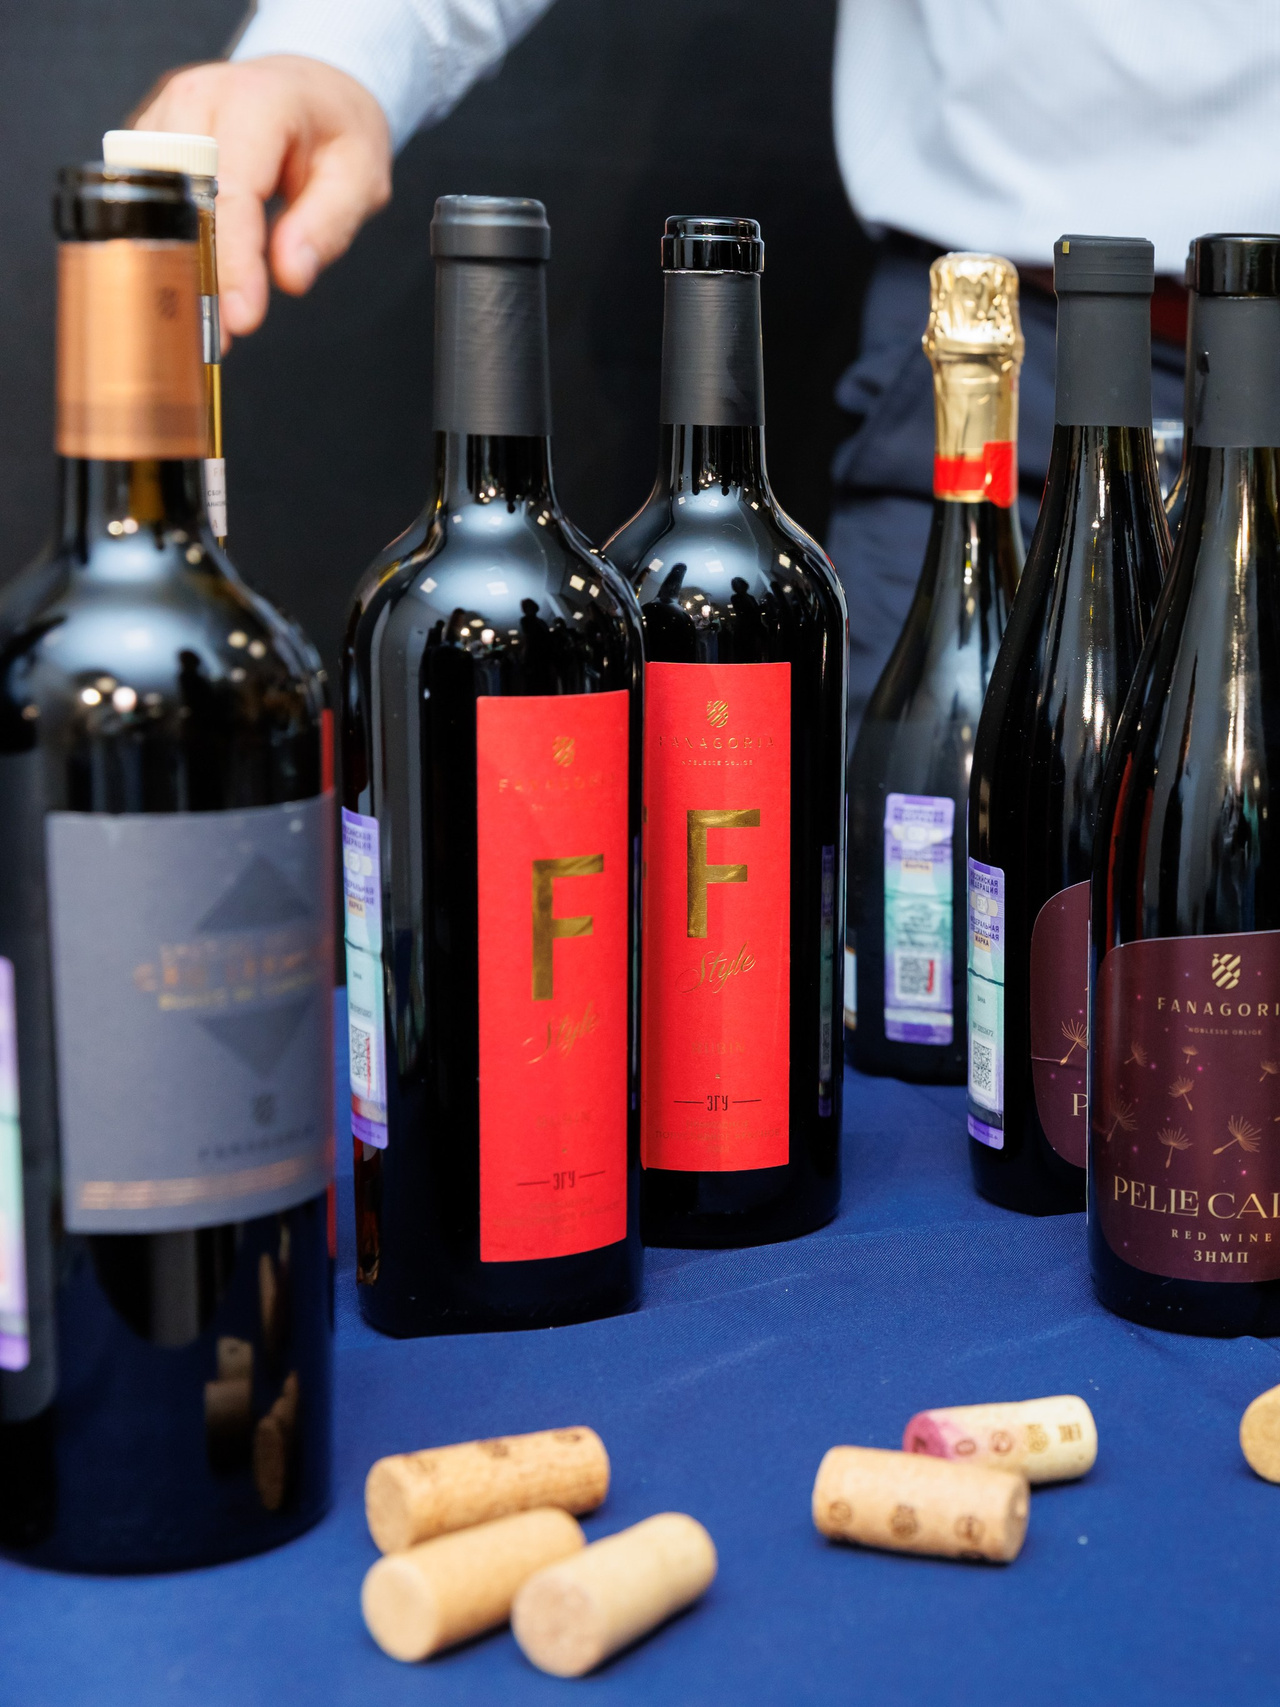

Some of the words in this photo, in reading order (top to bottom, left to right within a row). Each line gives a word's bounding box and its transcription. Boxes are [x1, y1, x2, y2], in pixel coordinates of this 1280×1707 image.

[687, 808, 761, 939] F
[531, 852, 605, 1001] F
[674, 940, 757, 994] Style
[706, 1094, 729, 1112] ЗГУ
[1171, 1228, 1207, 1241] RED
[1220, 1232, 1273, 1243] WINE
[1193, 1250, 1249, 1264] ЗНМП
